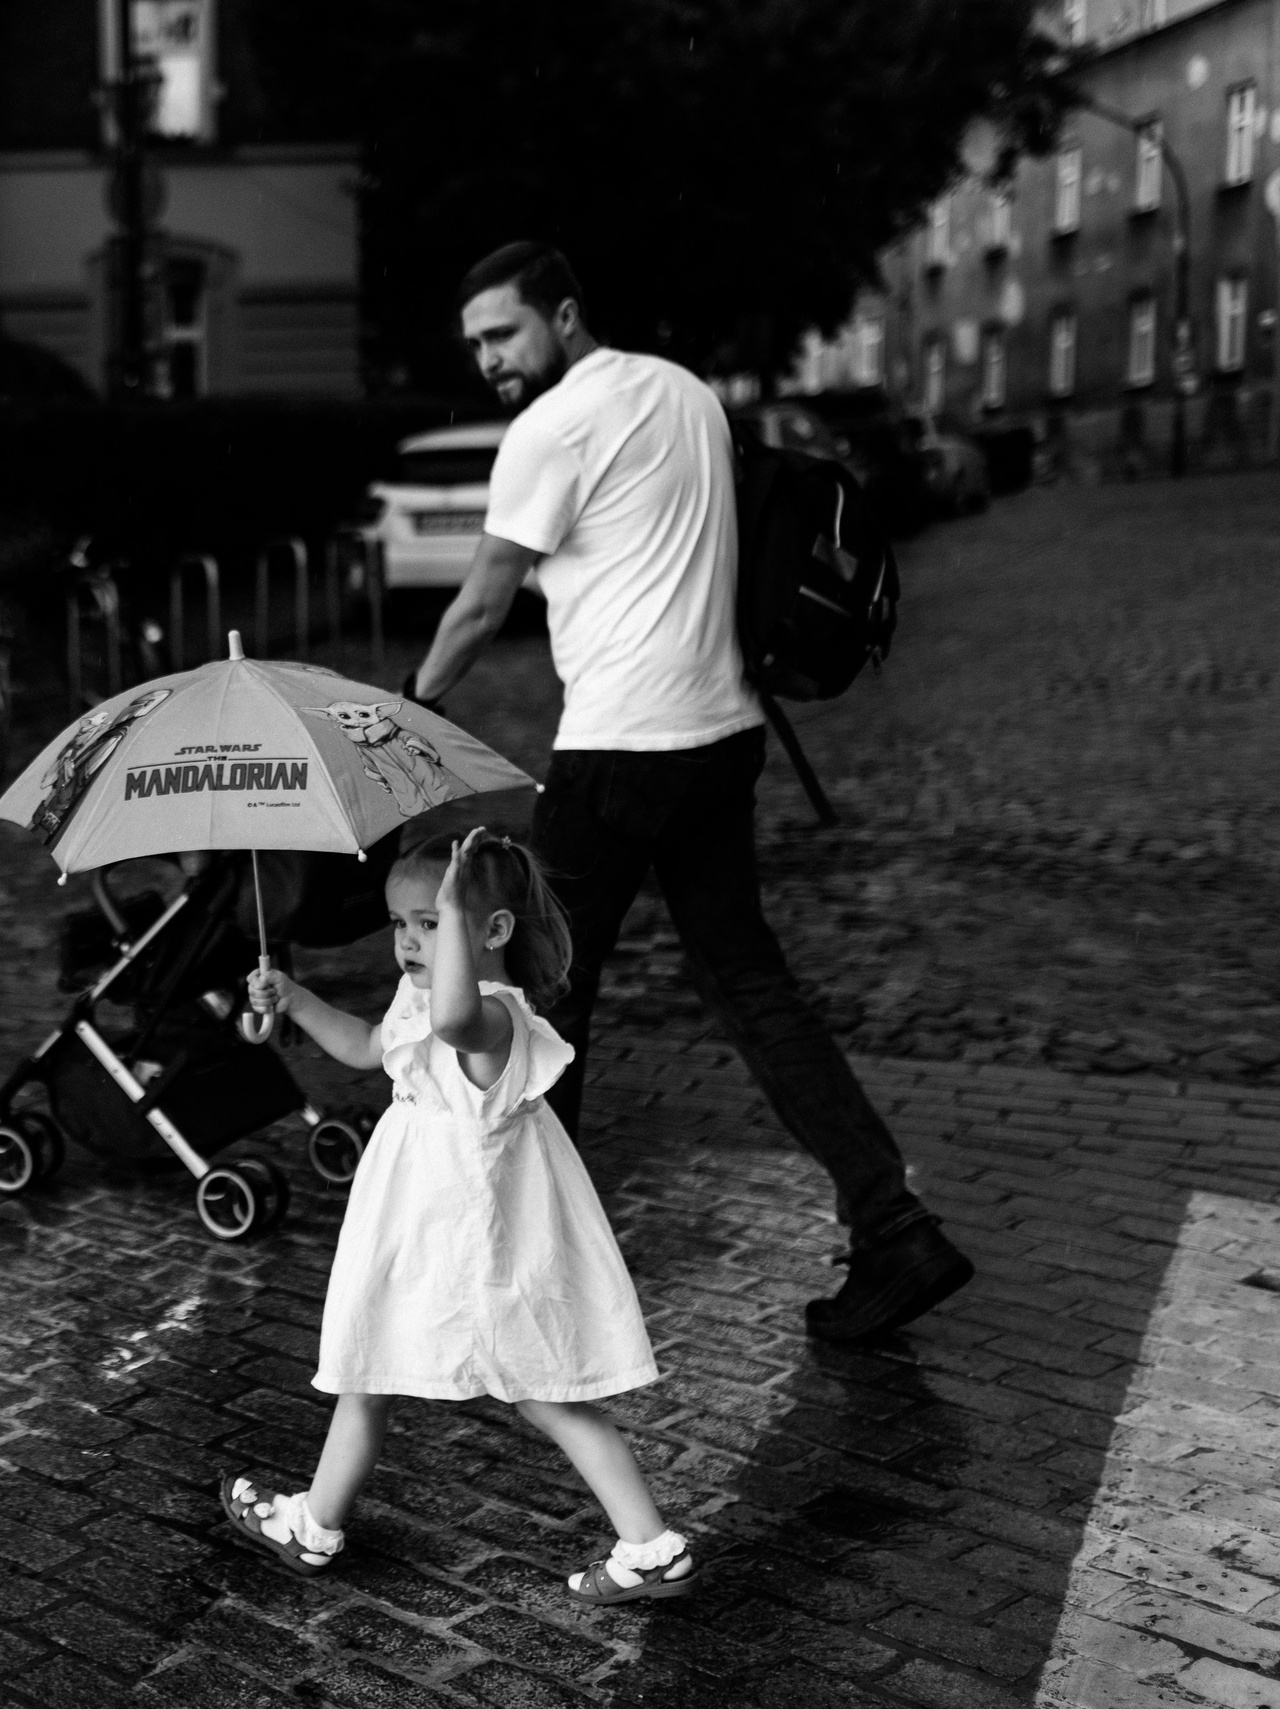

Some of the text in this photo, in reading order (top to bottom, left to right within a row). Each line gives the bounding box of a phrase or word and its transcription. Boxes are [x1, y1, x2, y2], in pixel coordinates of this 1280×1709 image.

[174, 743, 262, 756] STAR WARS
[124, 762, 308, 802] MANDALORIAN
